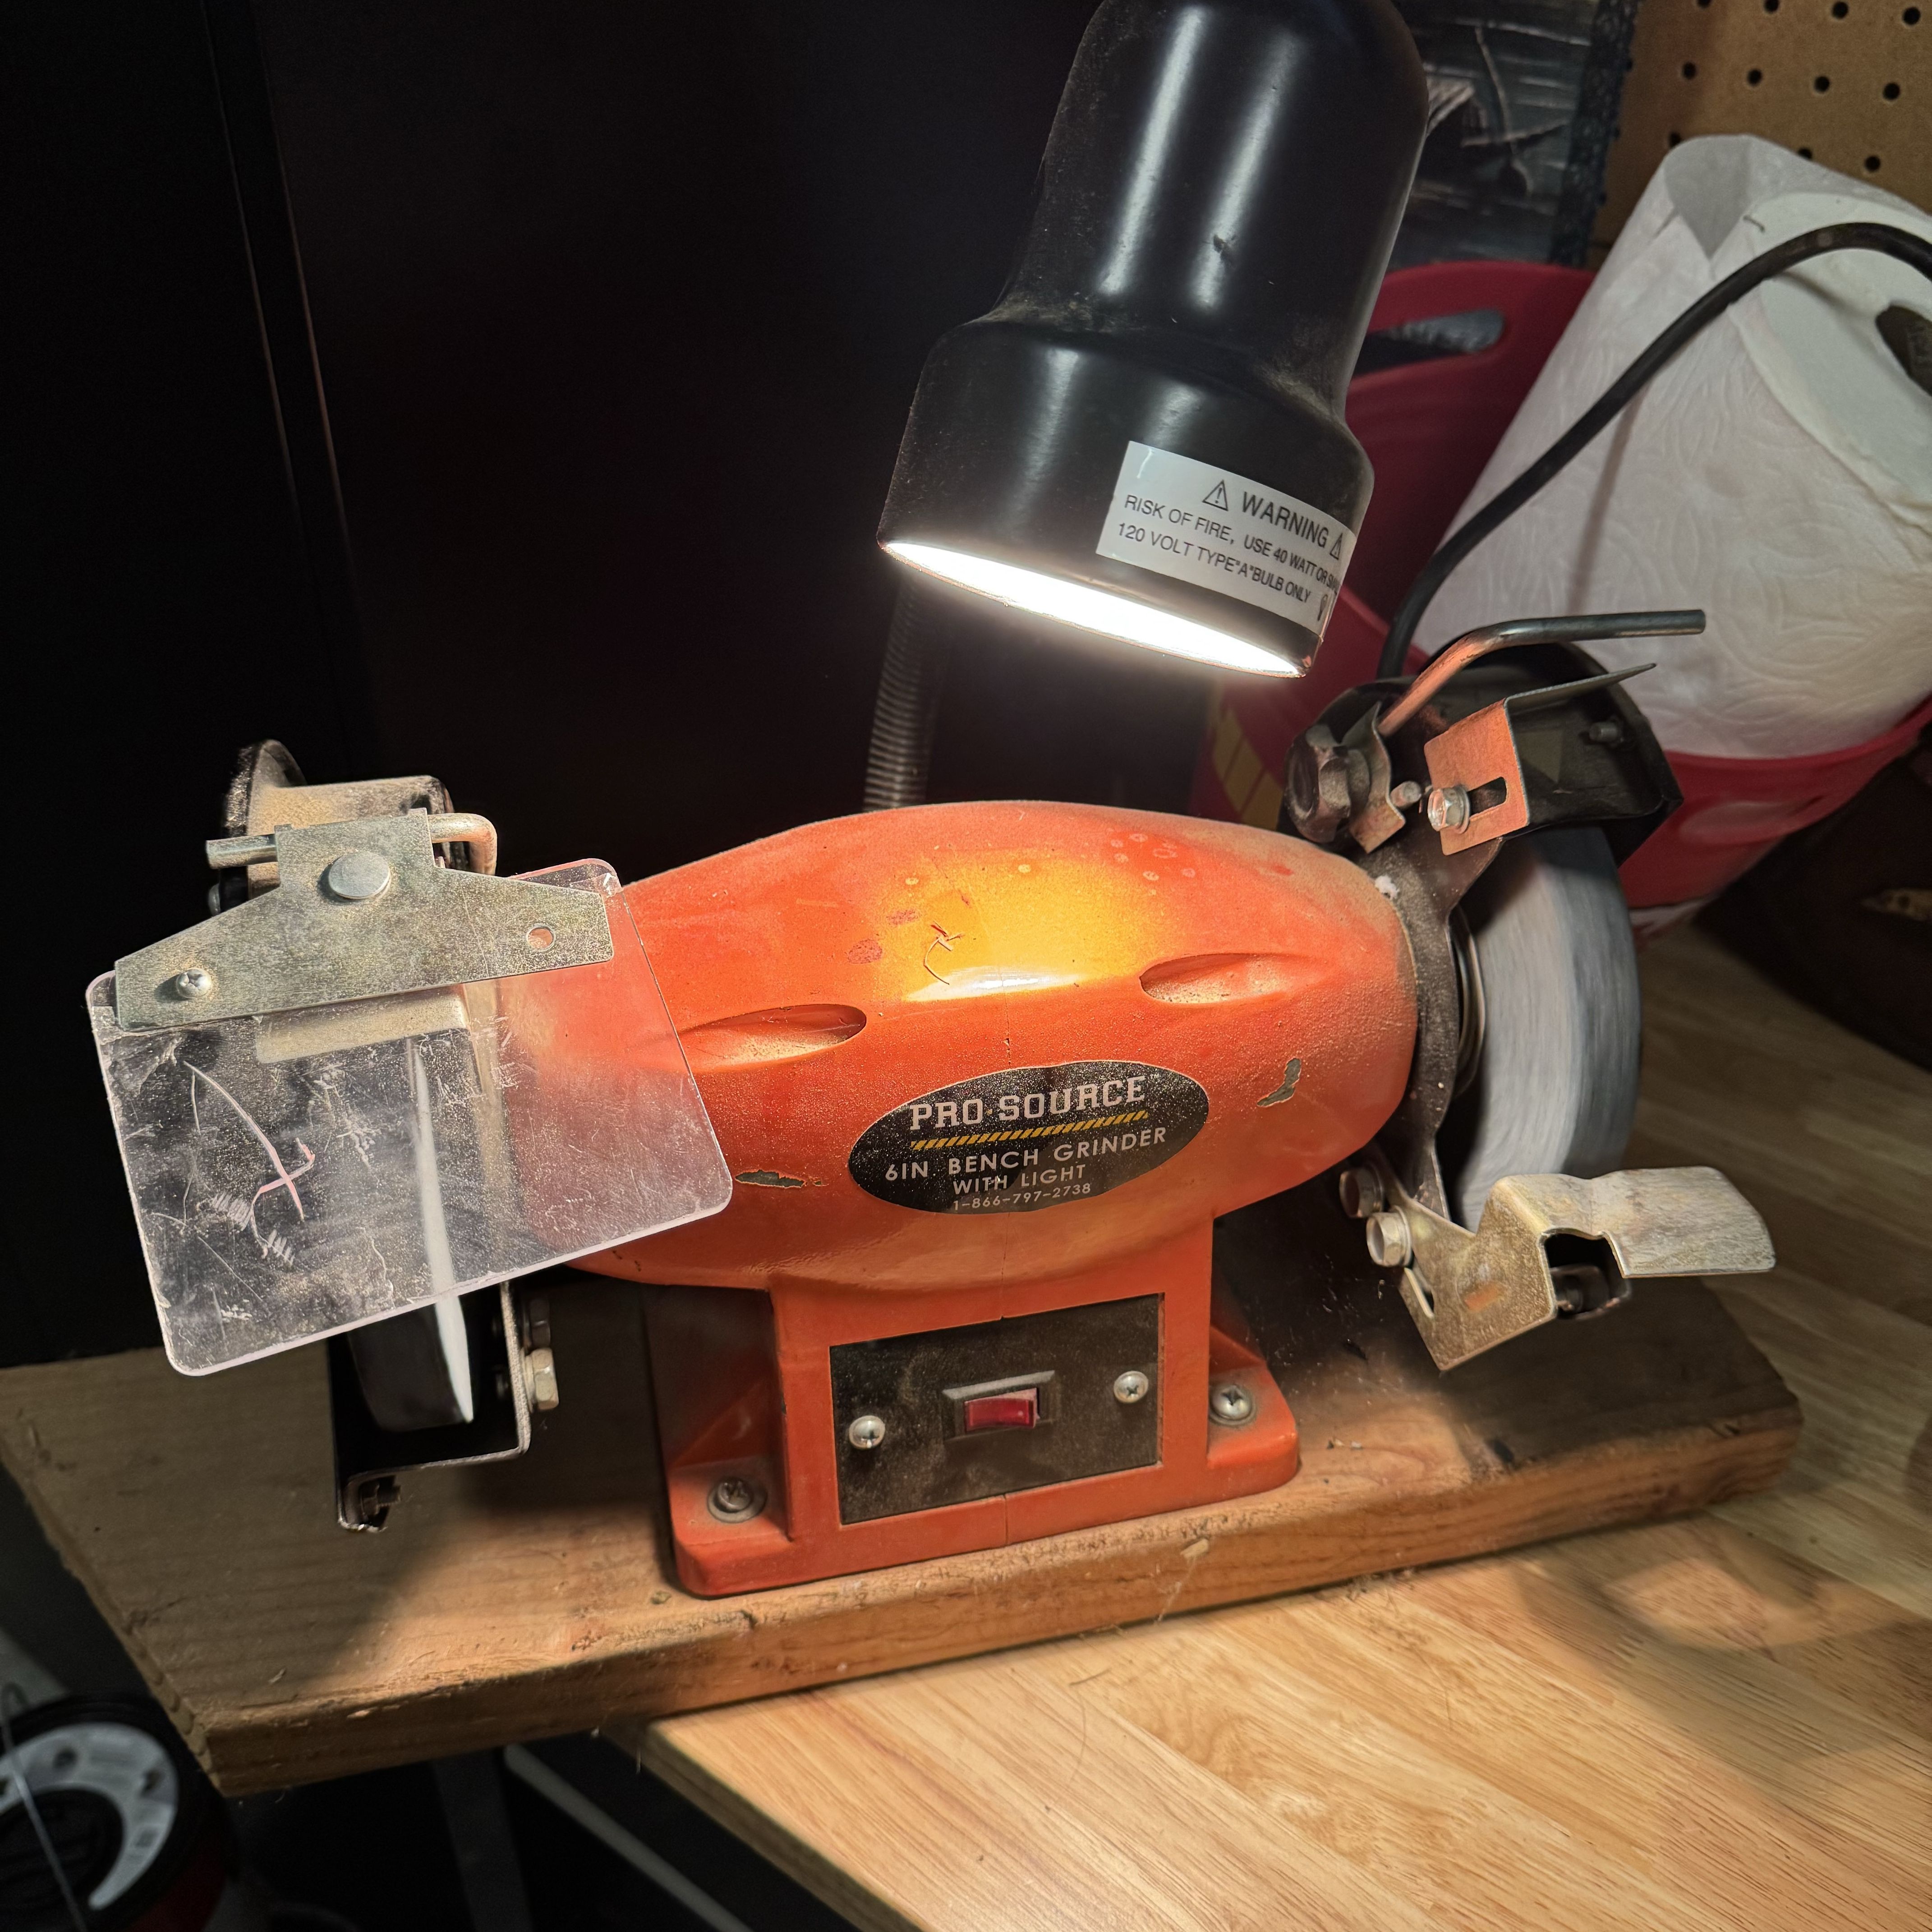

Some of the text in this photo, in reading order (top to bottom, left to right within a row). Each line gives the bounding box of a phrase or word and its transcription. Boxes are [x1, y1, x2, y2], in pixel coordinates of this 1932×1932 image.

[1124, 495, 1166, 519] RISK
[1168, 509, 1193, 525] OF
[1195, 517, 1234, 544] FIRE,
[1244, 534, 1273, 557] USE
[1274, 547, 1288, 563] 40
[1289, 552, 1317, 576] WATT
[1316, 567, 1328, 584] OR
[1242, 491, 1329, 548] WARNING
[1119, 523, 1145, 542] 120
[1151, 531, 1195, 556] VOLT
[1285, 582, 1311, 603] ONLY
[885, 1127, 1166, 1181] 6IN BENCH GRINDER
[953, 1164, 1086, 1195] WITH LIGHT
[953, 1182, 1091, 1211] 1-866-797-2738
